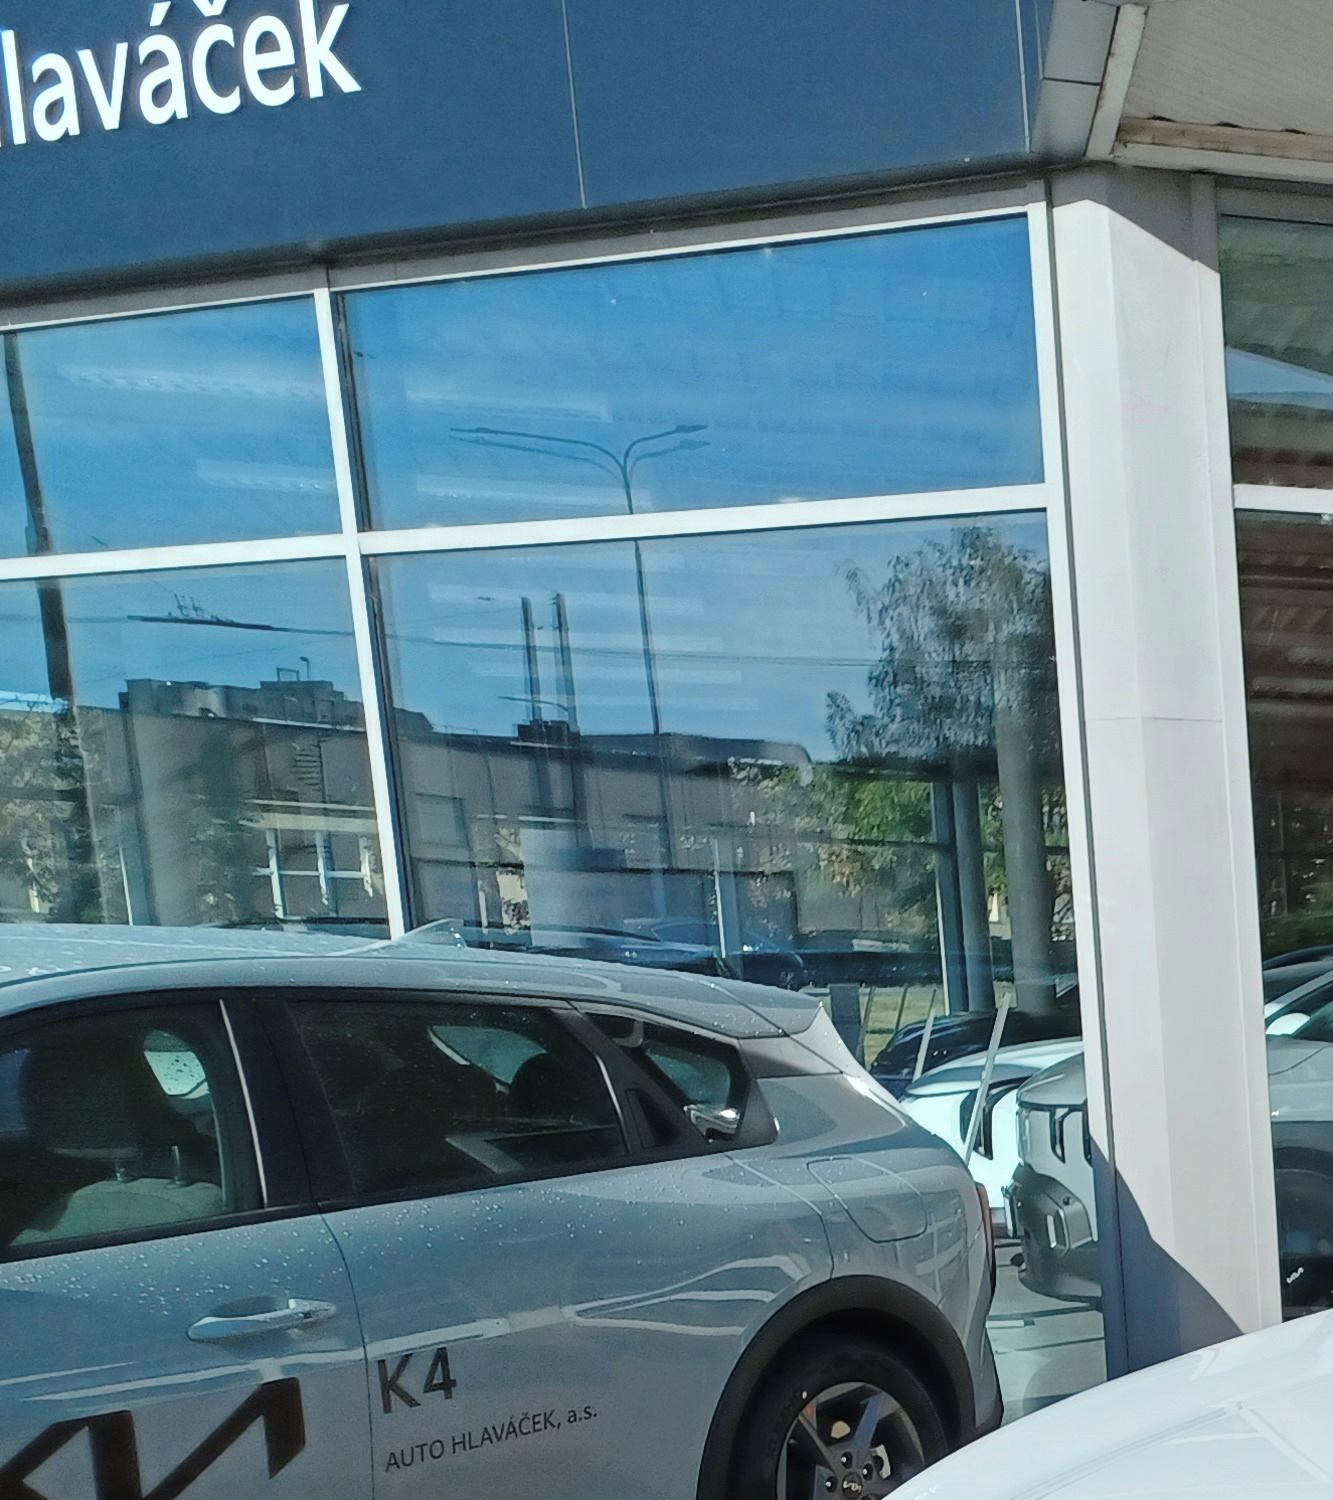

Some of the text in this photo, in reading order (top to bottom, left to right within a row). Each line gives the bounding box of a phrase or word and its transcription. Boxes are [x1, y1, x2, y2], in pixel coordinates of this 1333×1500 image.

[0, 0, 362, 147] laváček
[377, 1346, 457, 1414] K4
[385, 1404, 598, 1472] AUTO HLAVÁČEK, a.s.
